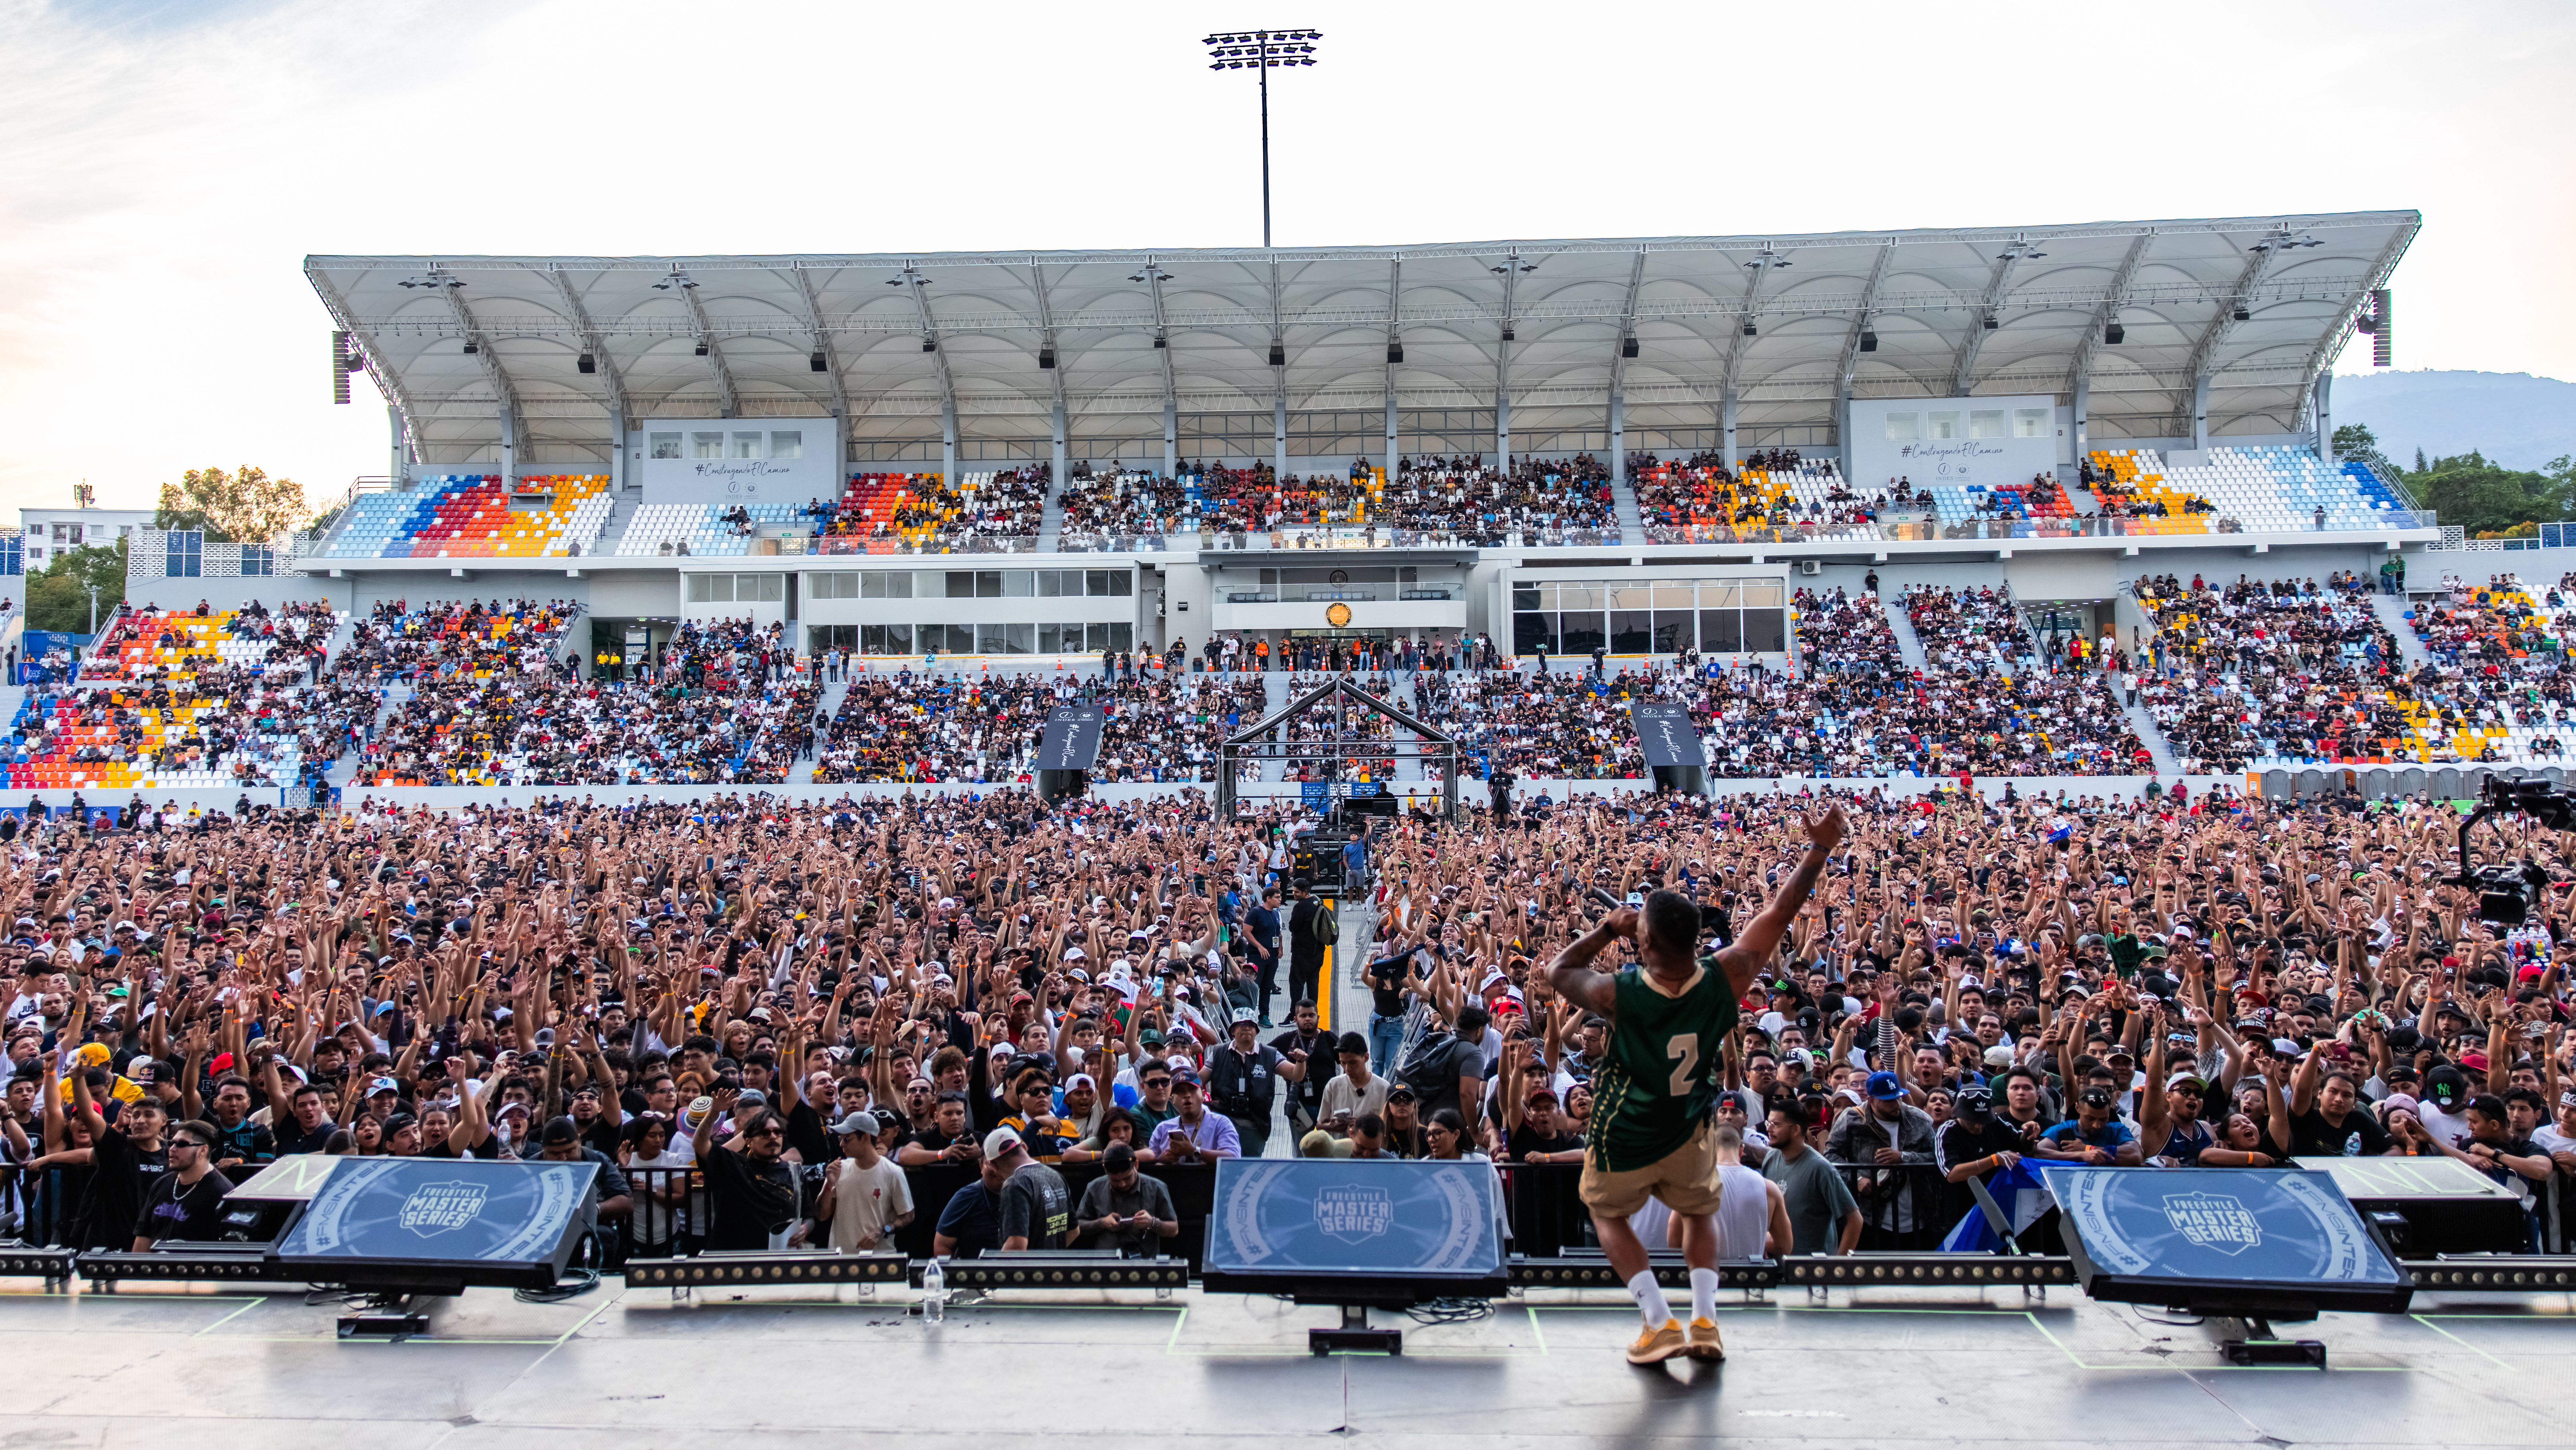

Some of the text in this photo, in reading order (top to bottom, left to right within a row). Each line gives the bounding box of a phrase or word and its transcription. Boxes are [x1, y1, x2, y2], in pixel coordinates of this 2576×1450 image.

[2048, 833, 2061, 841] epsi
[1150, 1030, 1158, 1039] NY
[1786, 1050, 1805, 1062] ICO
[1667, 1033, 1699, 1096] 2
[1886, 1079, 1896, 1090] LA
[2437, 1083, 2451, 1095] NY
[240, 1134, 251, 1146] H
[423, 1188, 479, 1197] FREESTYLE
[1326, 1192, 1380, 1200] FREESTYLE
[406, 1196, 482, 1213] MASTER
[1318, 1201, 1389, 1217] MASTER
[2173, 1200, 2235, 1209] FREESTYLE
[405, 1211, 469, 1227] SERIES
[1323, 1216, 1385, 1233] SERIES
[2170, 1210, 2255, 1227] MASTER
[2183, 1225, 2255, 1242] SERIES
